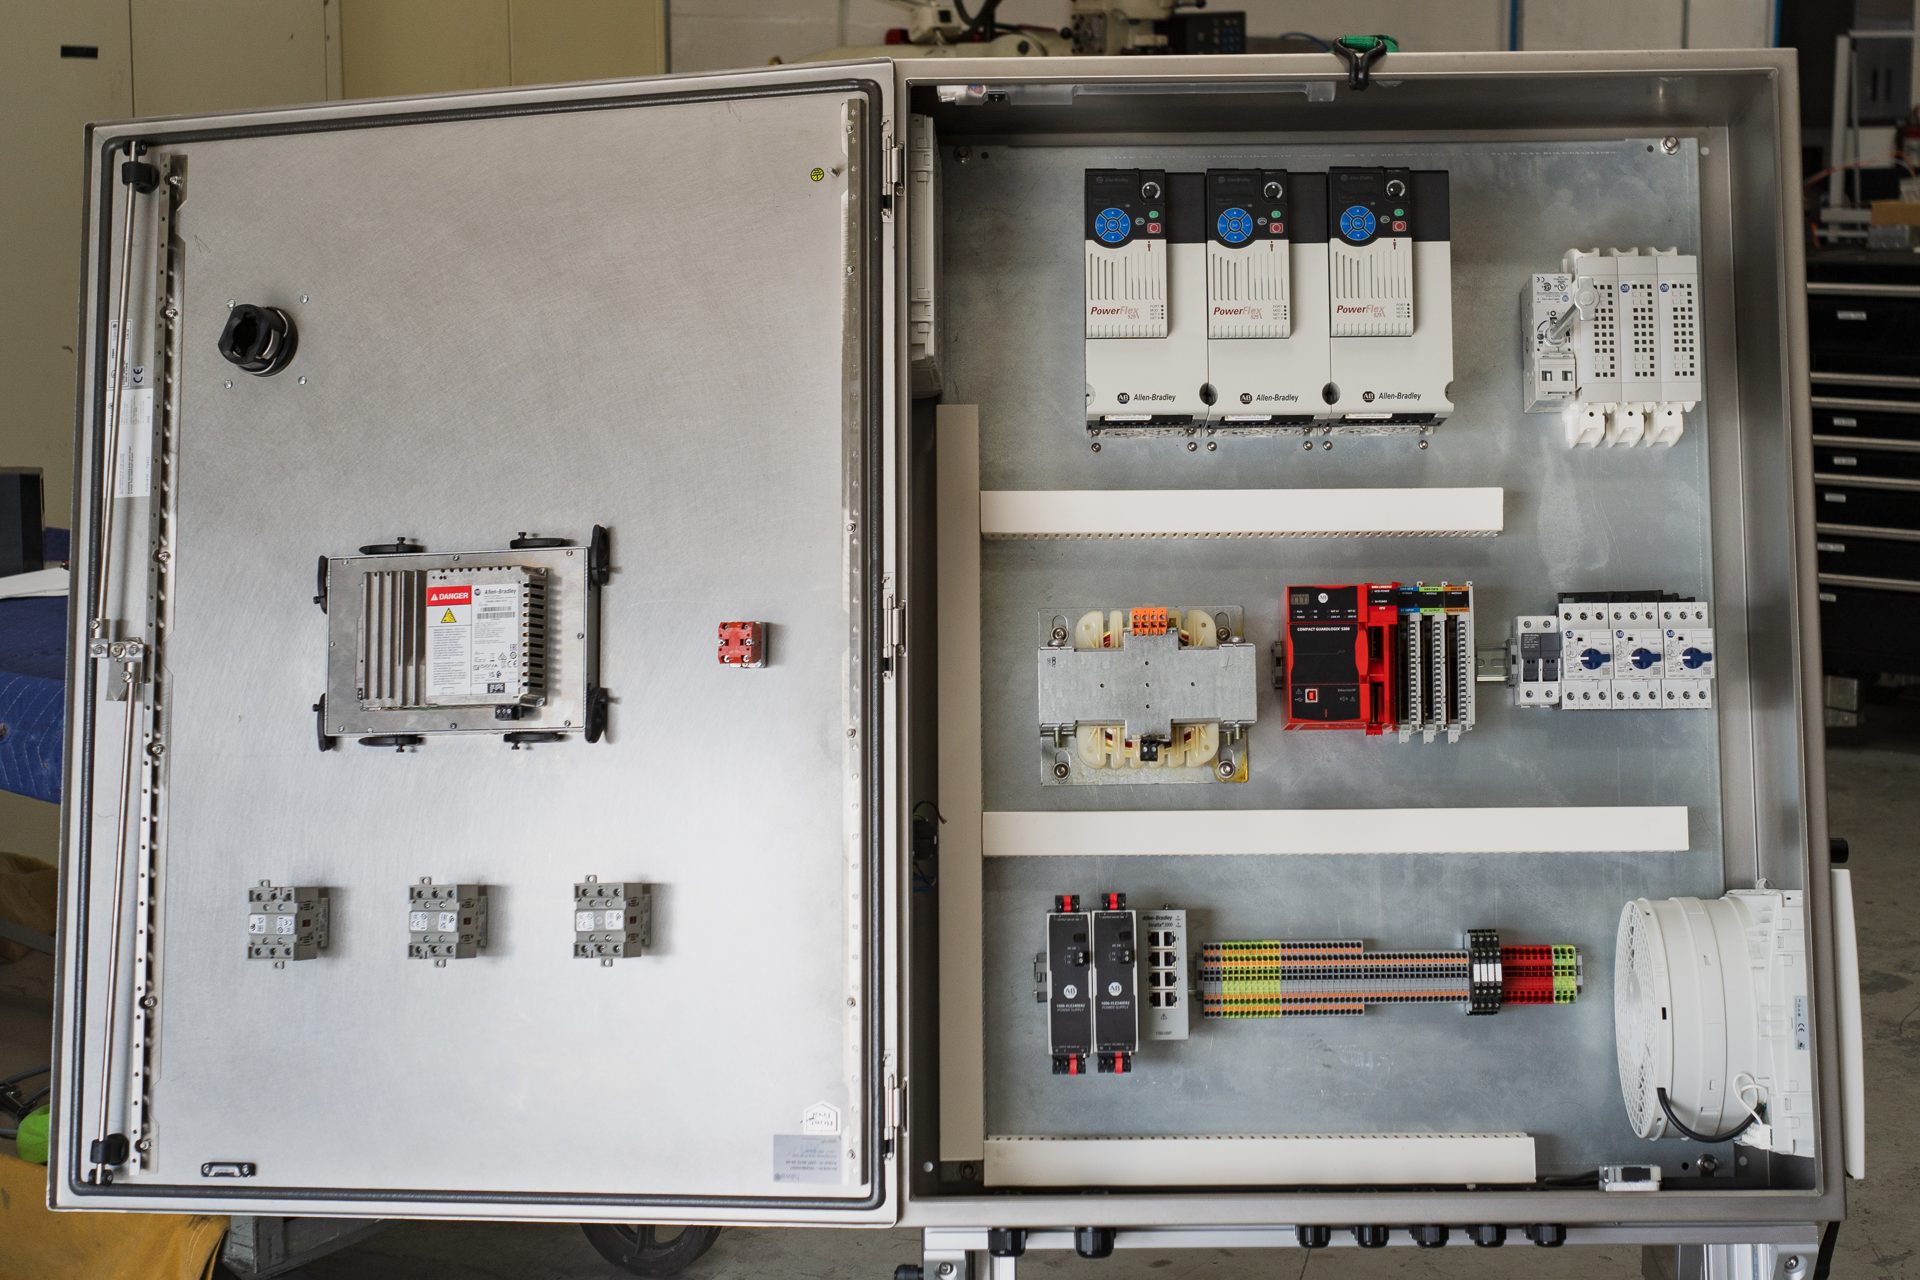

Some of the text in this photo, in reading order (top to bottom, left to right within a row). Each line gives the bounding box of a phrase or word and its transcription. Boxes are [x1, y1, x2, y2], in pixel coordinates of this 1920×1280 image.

[1090, 306, 1139, 318] PowerFlex
[1213, 306, 1262, 318] PowerFlex
[1336, 304, 1385, 316] PowerFlex
[1133, 393, 1176, 403] Allen-Bradley
[1256, 393, 1299, 403] Allen-Bradley
[1378, 391, 1421, 401] Allen-Bradley
[439, 592, 468, 601] DANGER
